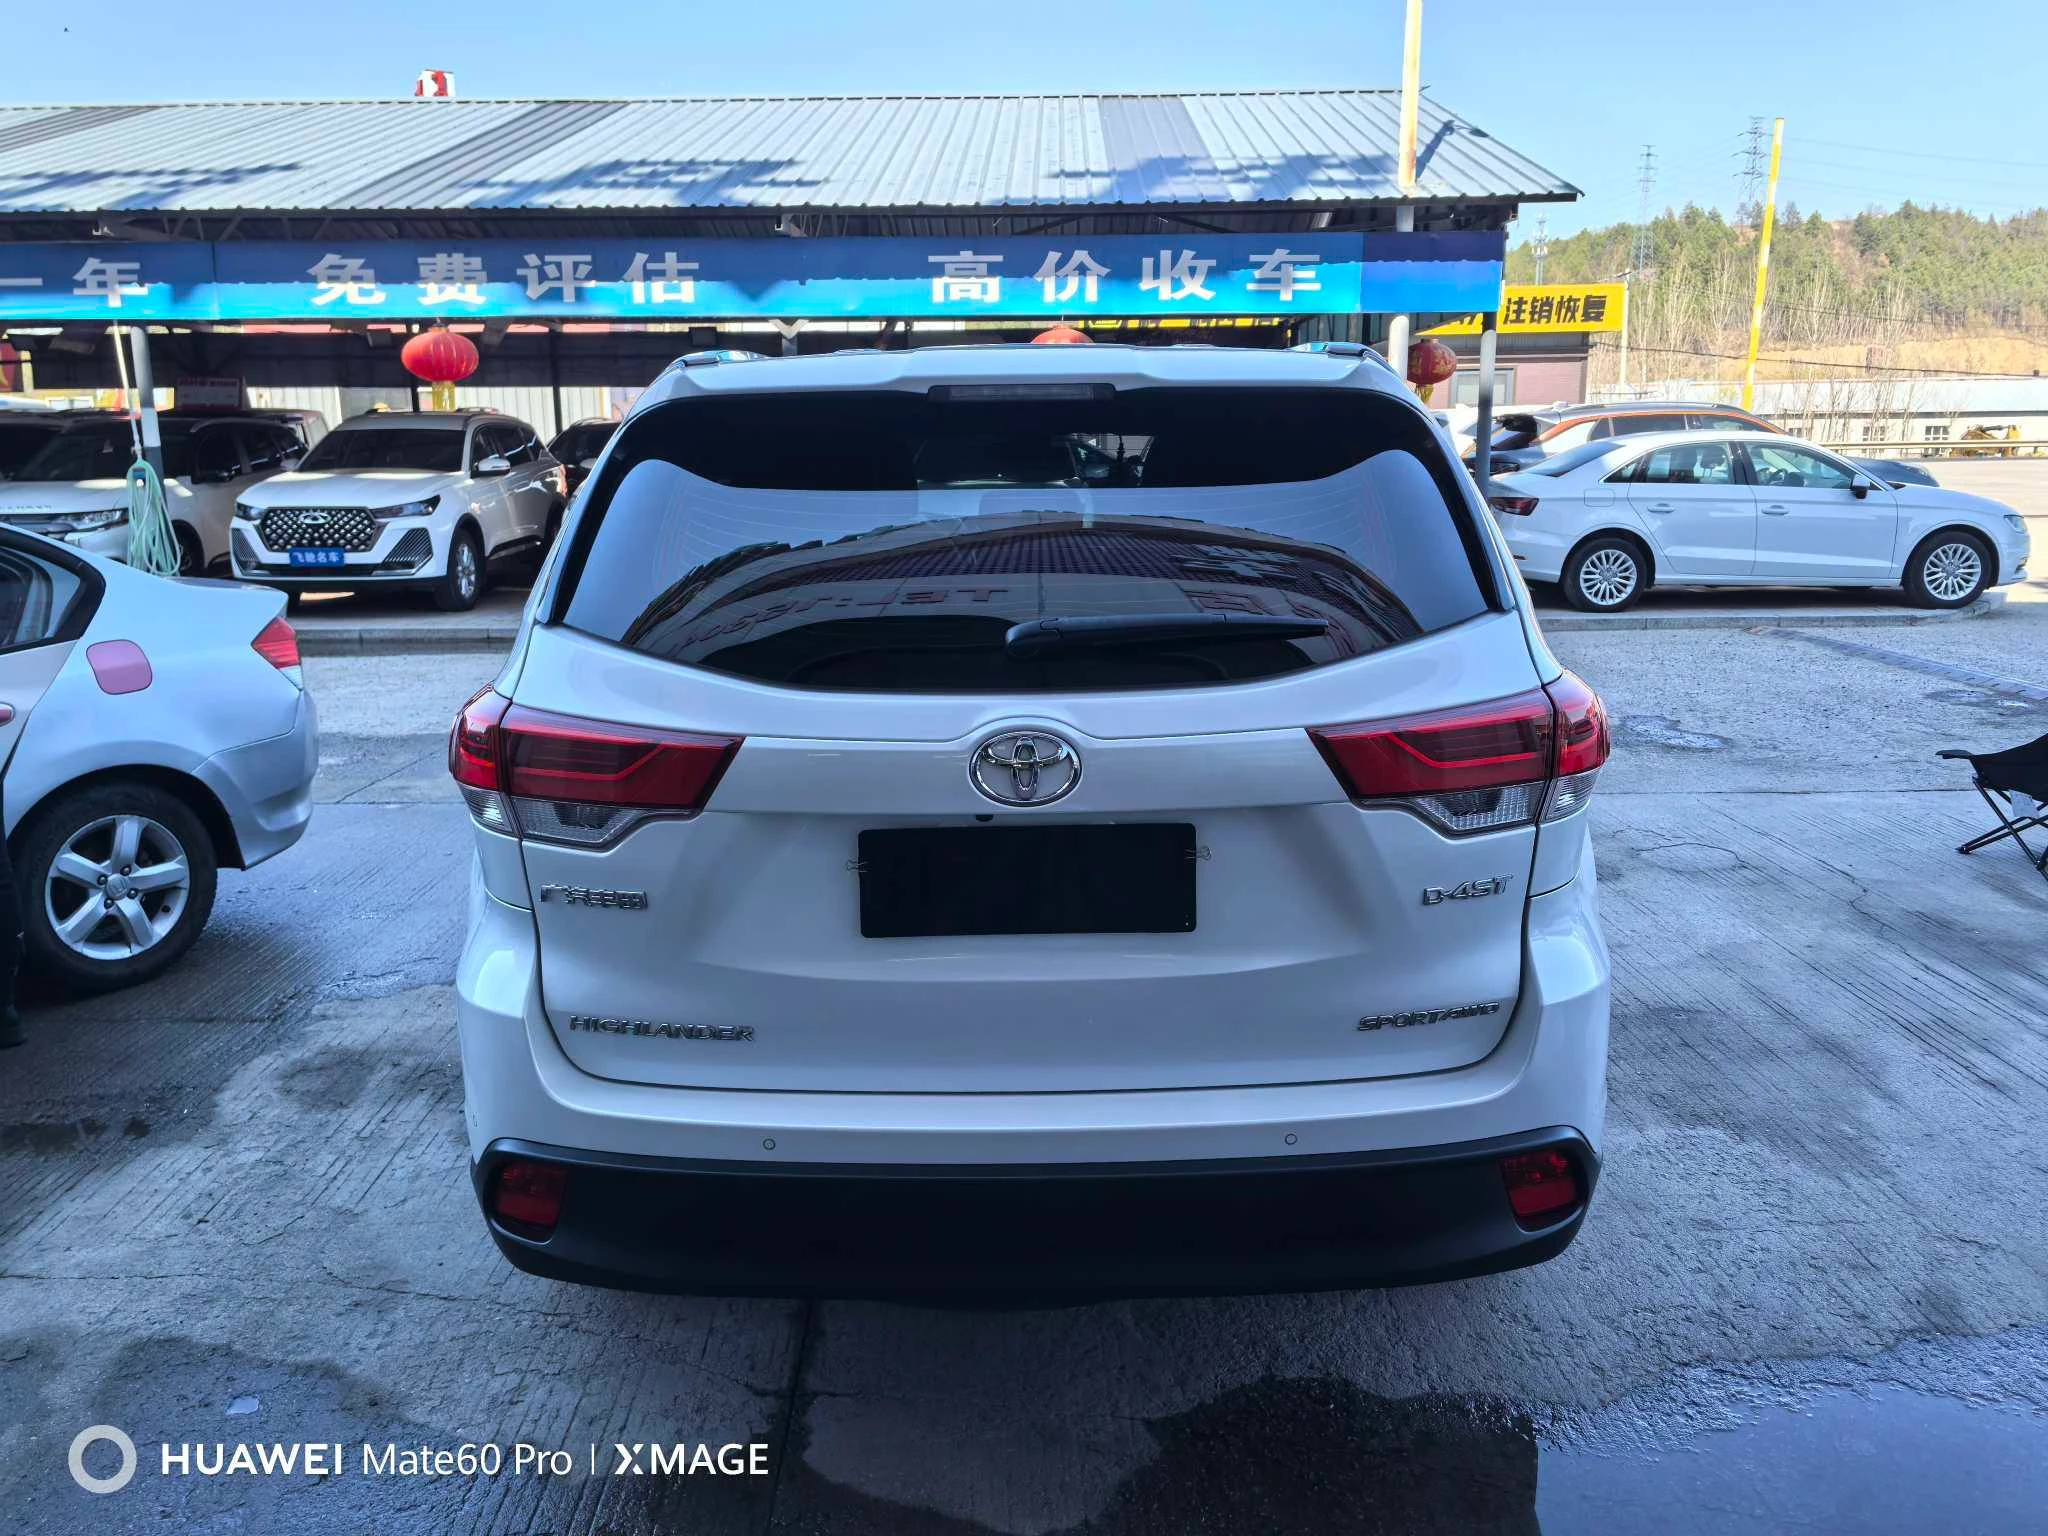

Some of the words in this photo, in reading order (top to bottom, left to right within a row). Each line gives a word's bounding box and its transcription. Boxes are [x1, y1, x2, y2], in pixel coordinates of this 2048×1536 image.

[306, 252, 700, 305] 免费评估
[927, 248, 1322, 303] 高价收车
[1503, 295, 1607, 325] 注销恢复
[569, 1015, 754, 1041] HIGHLANDER
